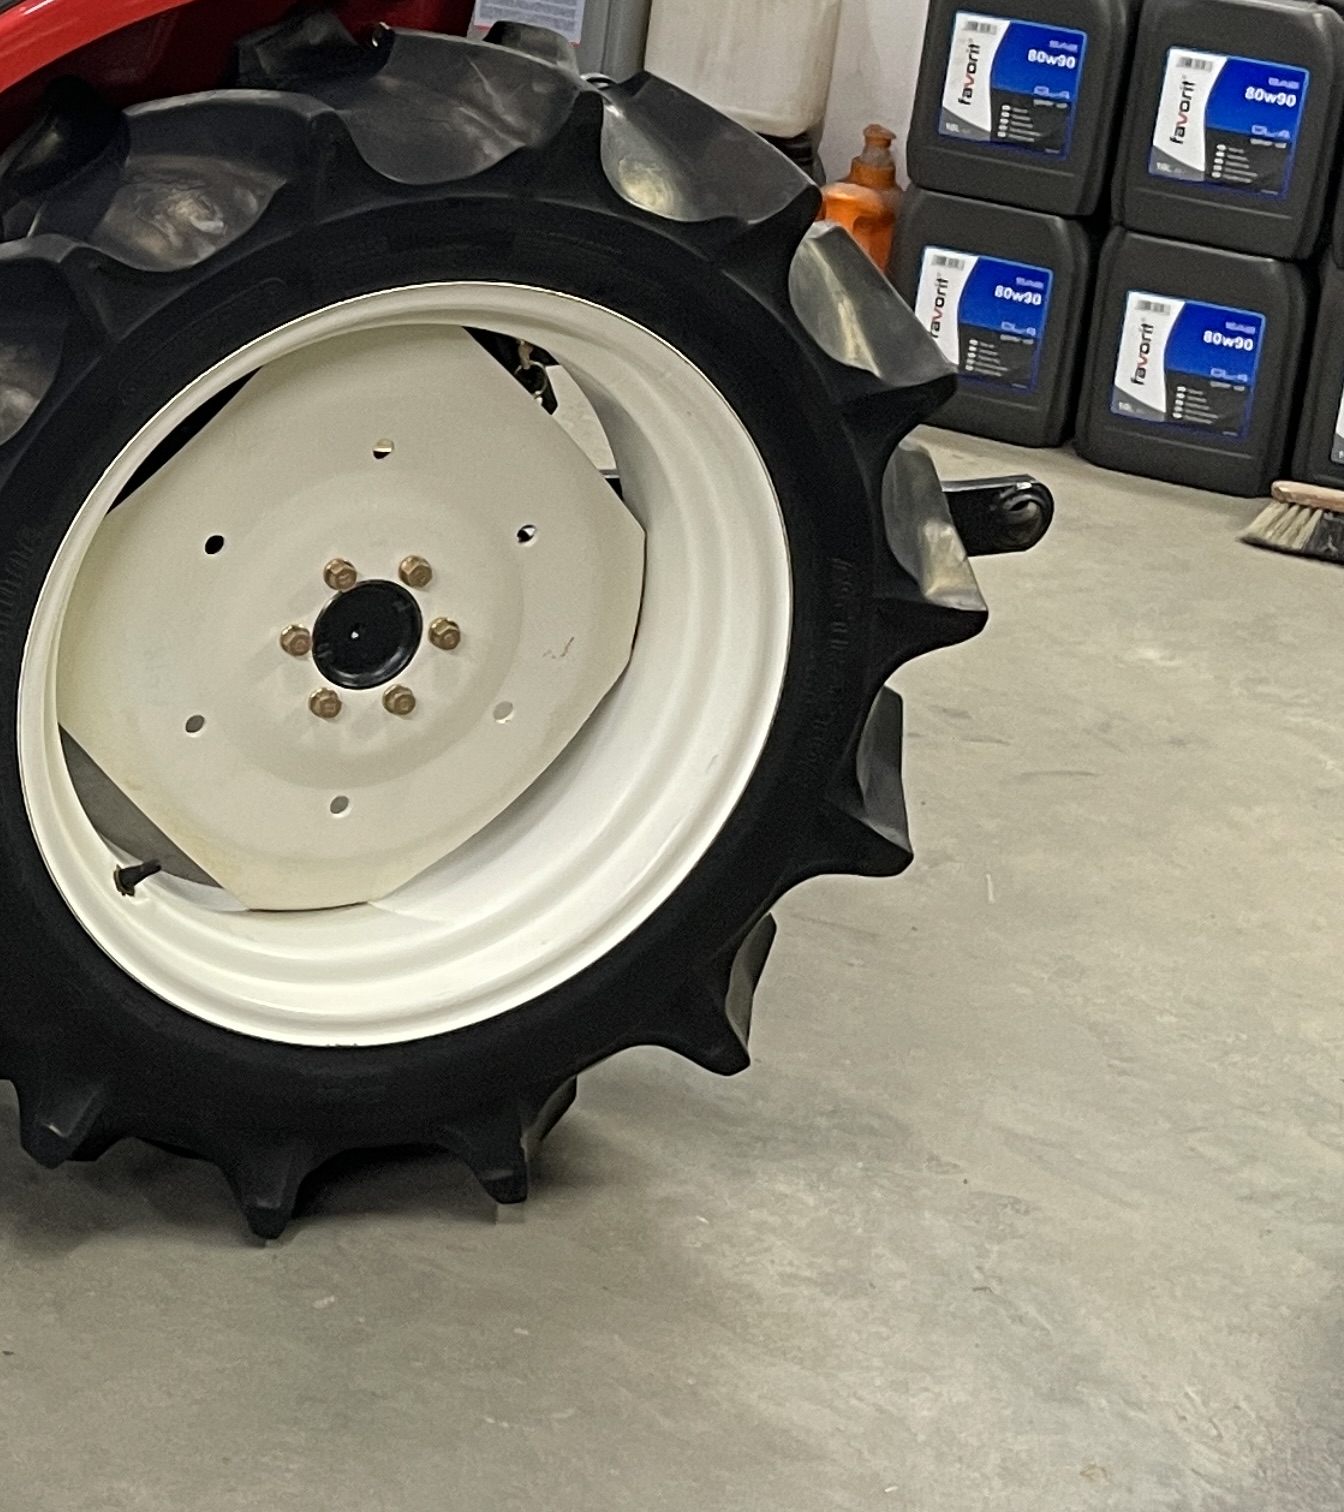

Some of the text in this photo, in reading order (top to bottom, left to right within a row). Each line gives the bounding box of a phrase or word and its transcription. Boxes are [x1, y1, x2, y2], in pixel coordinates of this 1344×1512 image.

[1028, 49, 1076, 69] 80w90
[958, 43, 980, 105] favorit
[1245, 86, 1297, 107] 80w90
[1169, 80, 1196, 144] favorit
[994, 285, 1042, 306] 80w90
[1203, 330, 1254, 351] 80w90
[1131, 323, 1154, 385] favorit
